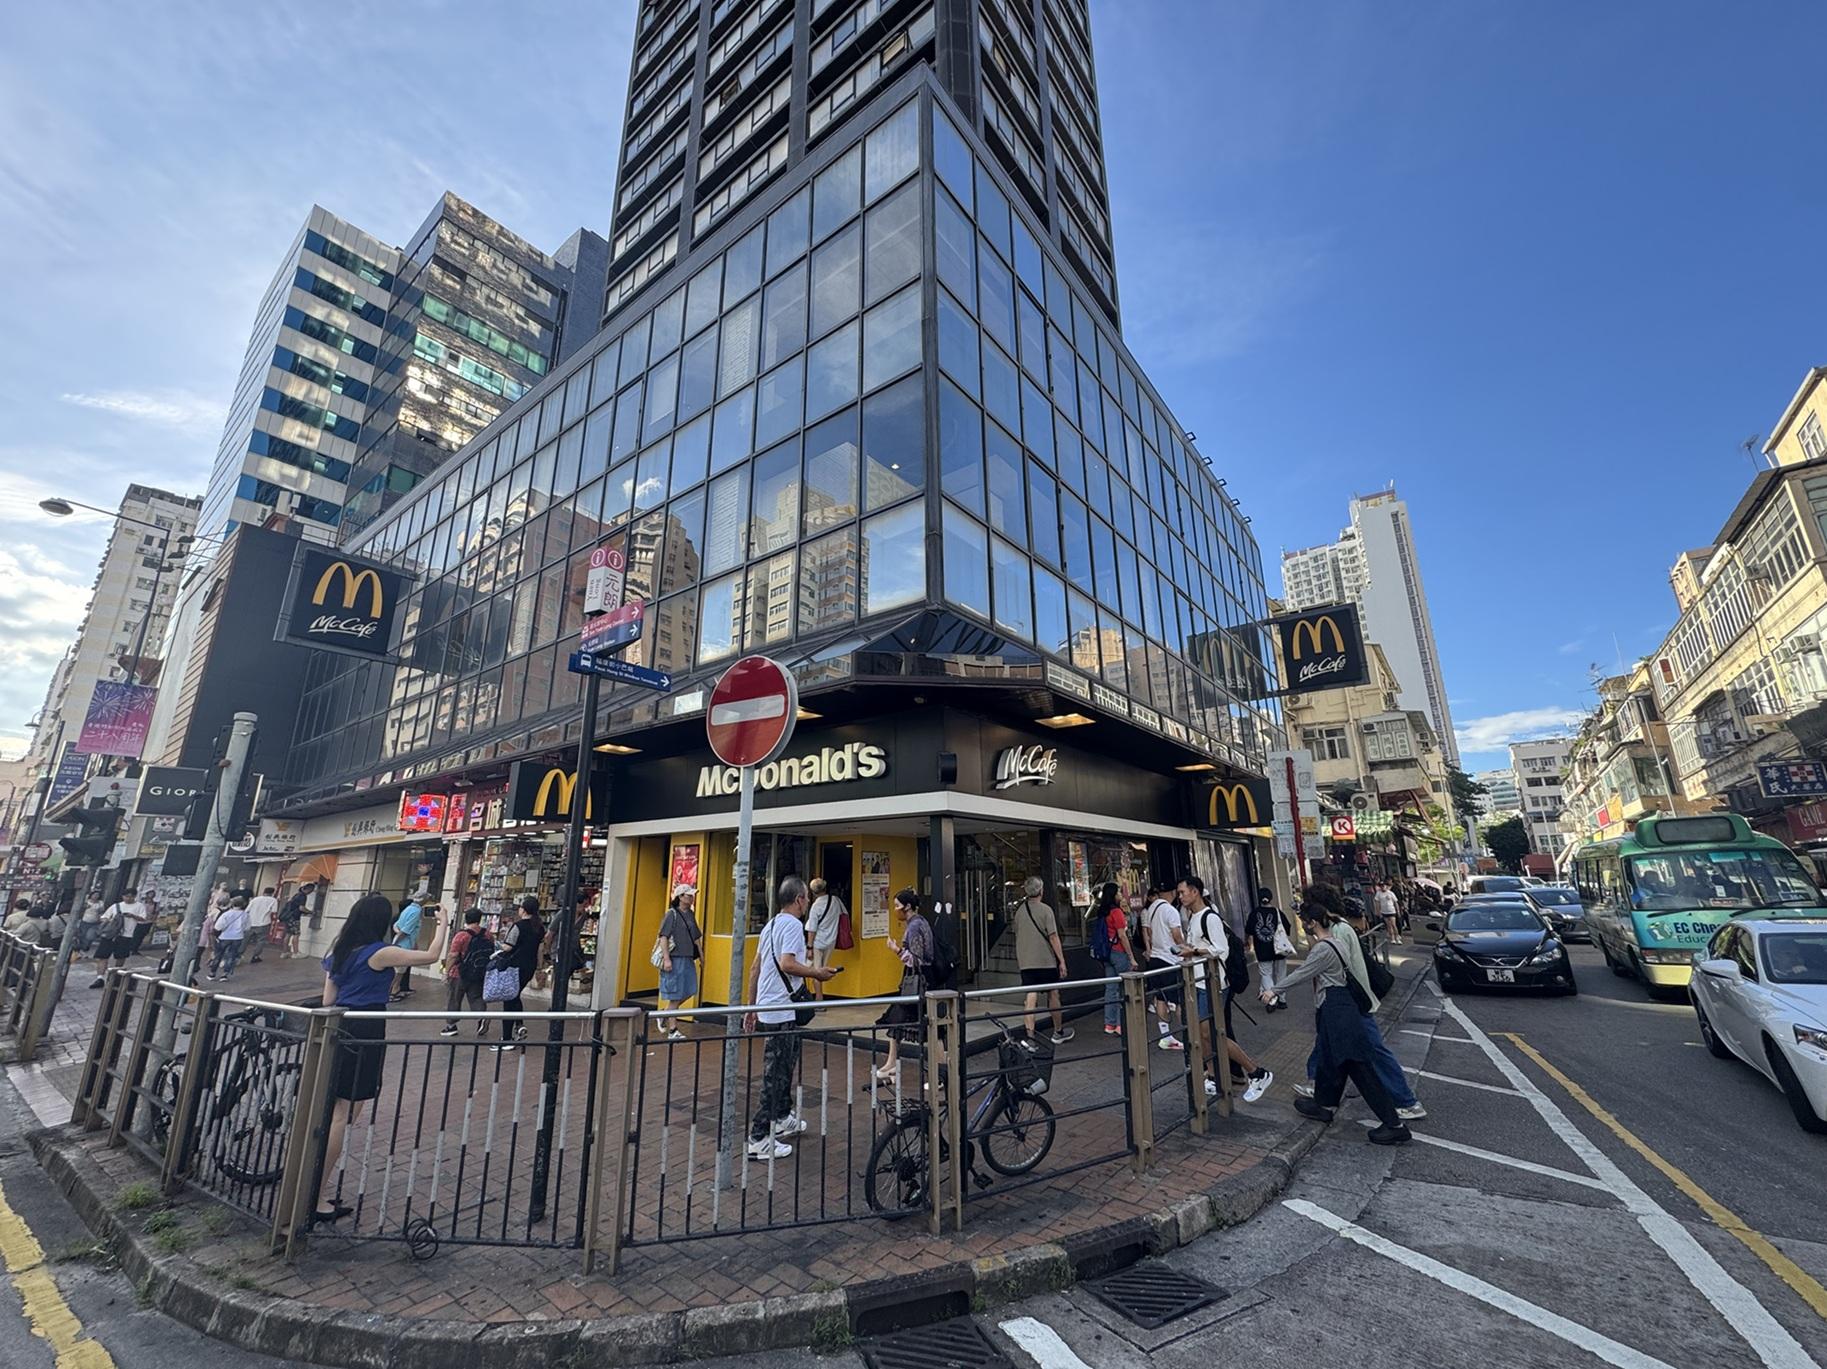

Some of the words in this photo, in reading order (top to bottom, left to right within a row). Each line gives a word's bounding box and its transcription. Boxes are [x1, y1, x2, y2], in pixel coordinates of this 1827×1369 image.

[604, 573, 619, 608] 元朗
[996, 745, 1057, 789] McCafé
[1674, 922, 1690, 934] EC
